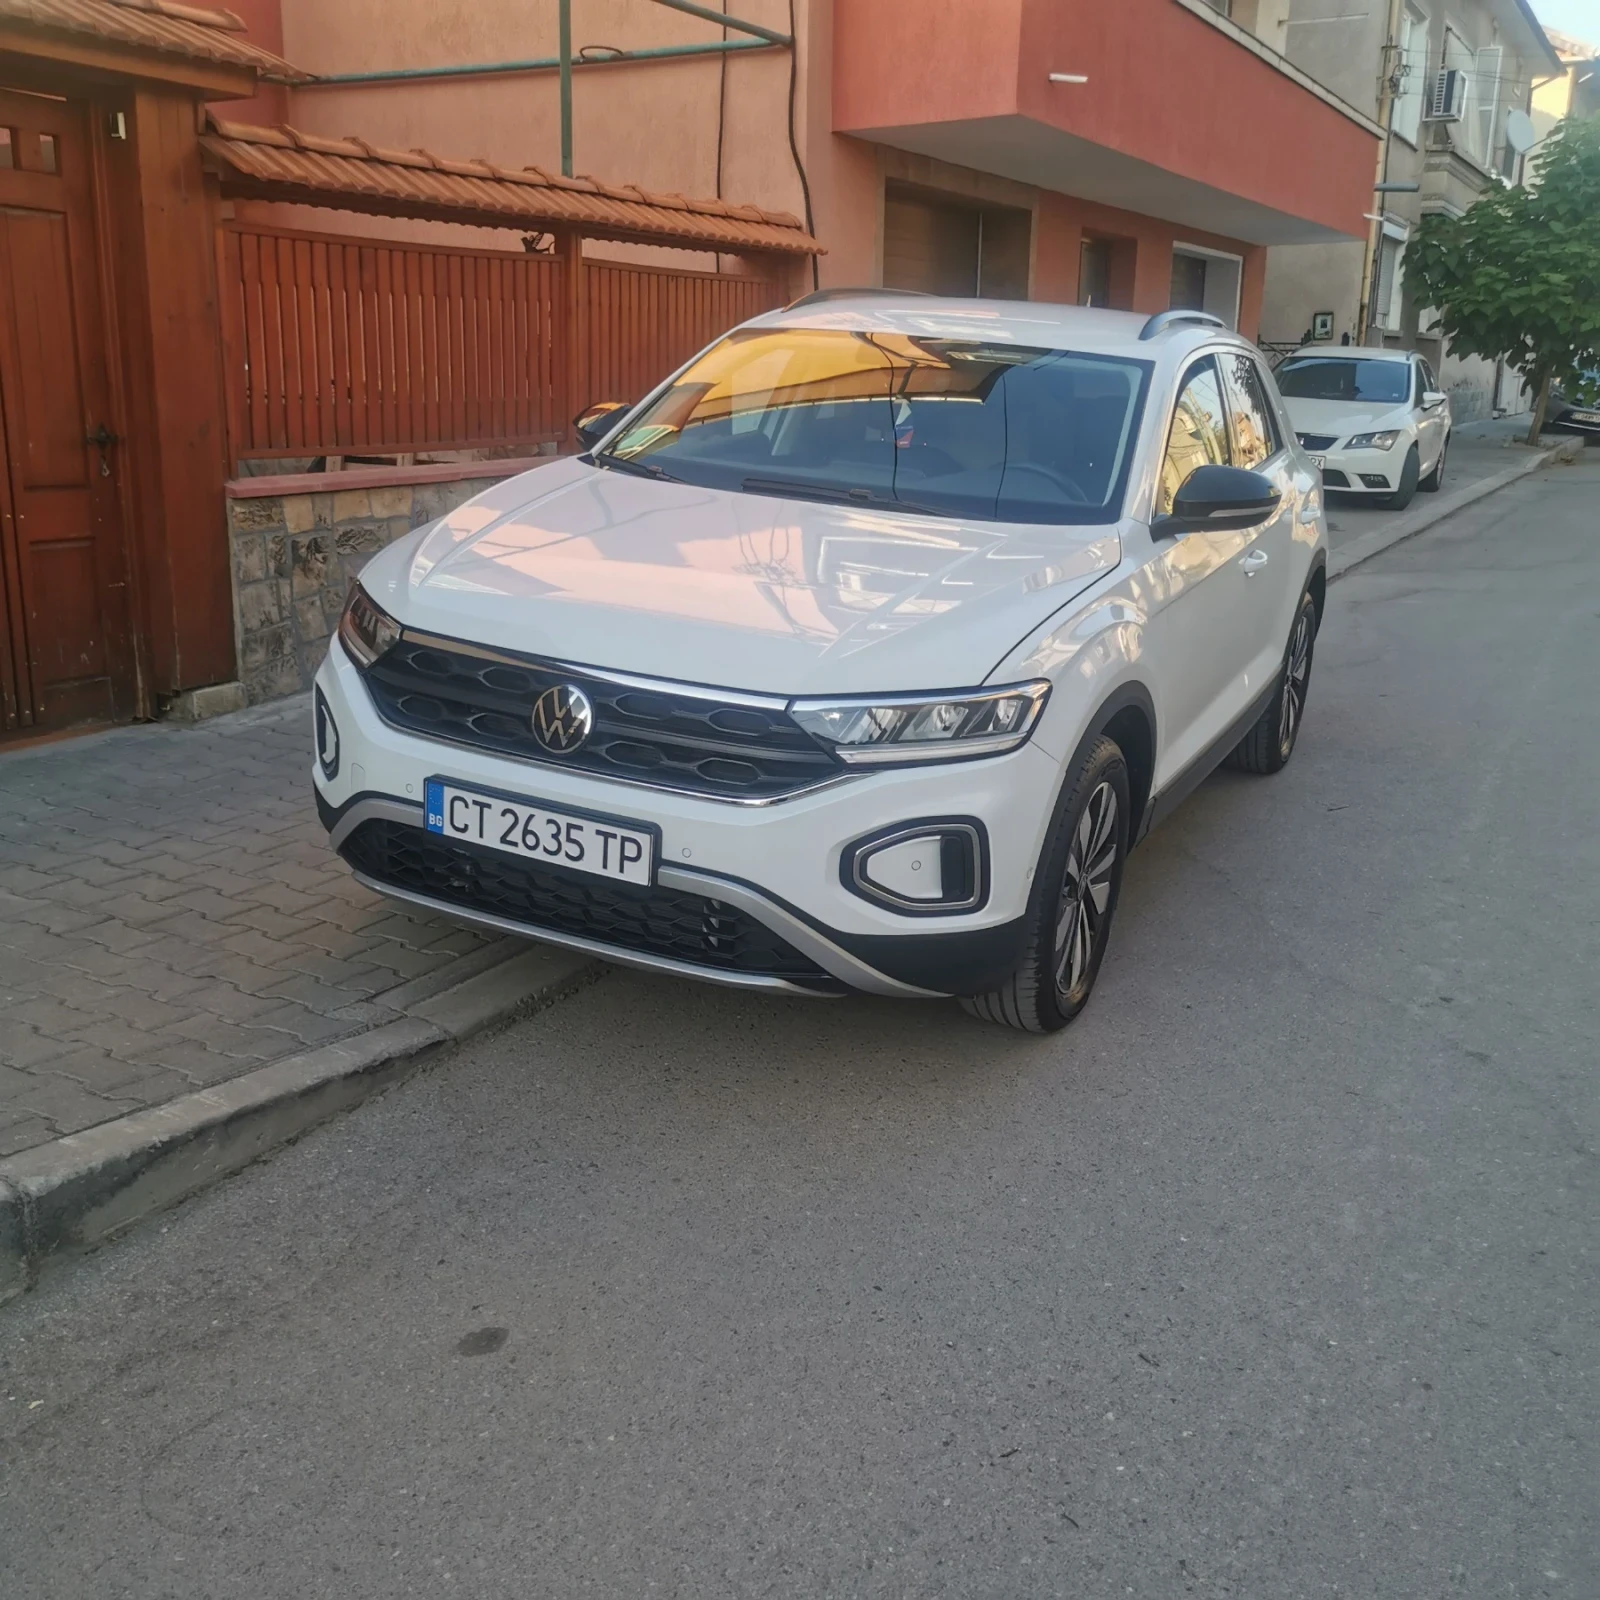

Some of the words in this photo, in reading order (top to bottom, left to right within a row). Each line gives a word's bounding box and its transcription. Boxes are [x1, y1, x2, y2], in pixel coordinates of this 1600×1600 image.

[428, 812, 443, 827] BG
[450, 795, 492, 838] CT
[500, 808, 585, 862] 2635
[595, 829, 643, 873] TP
